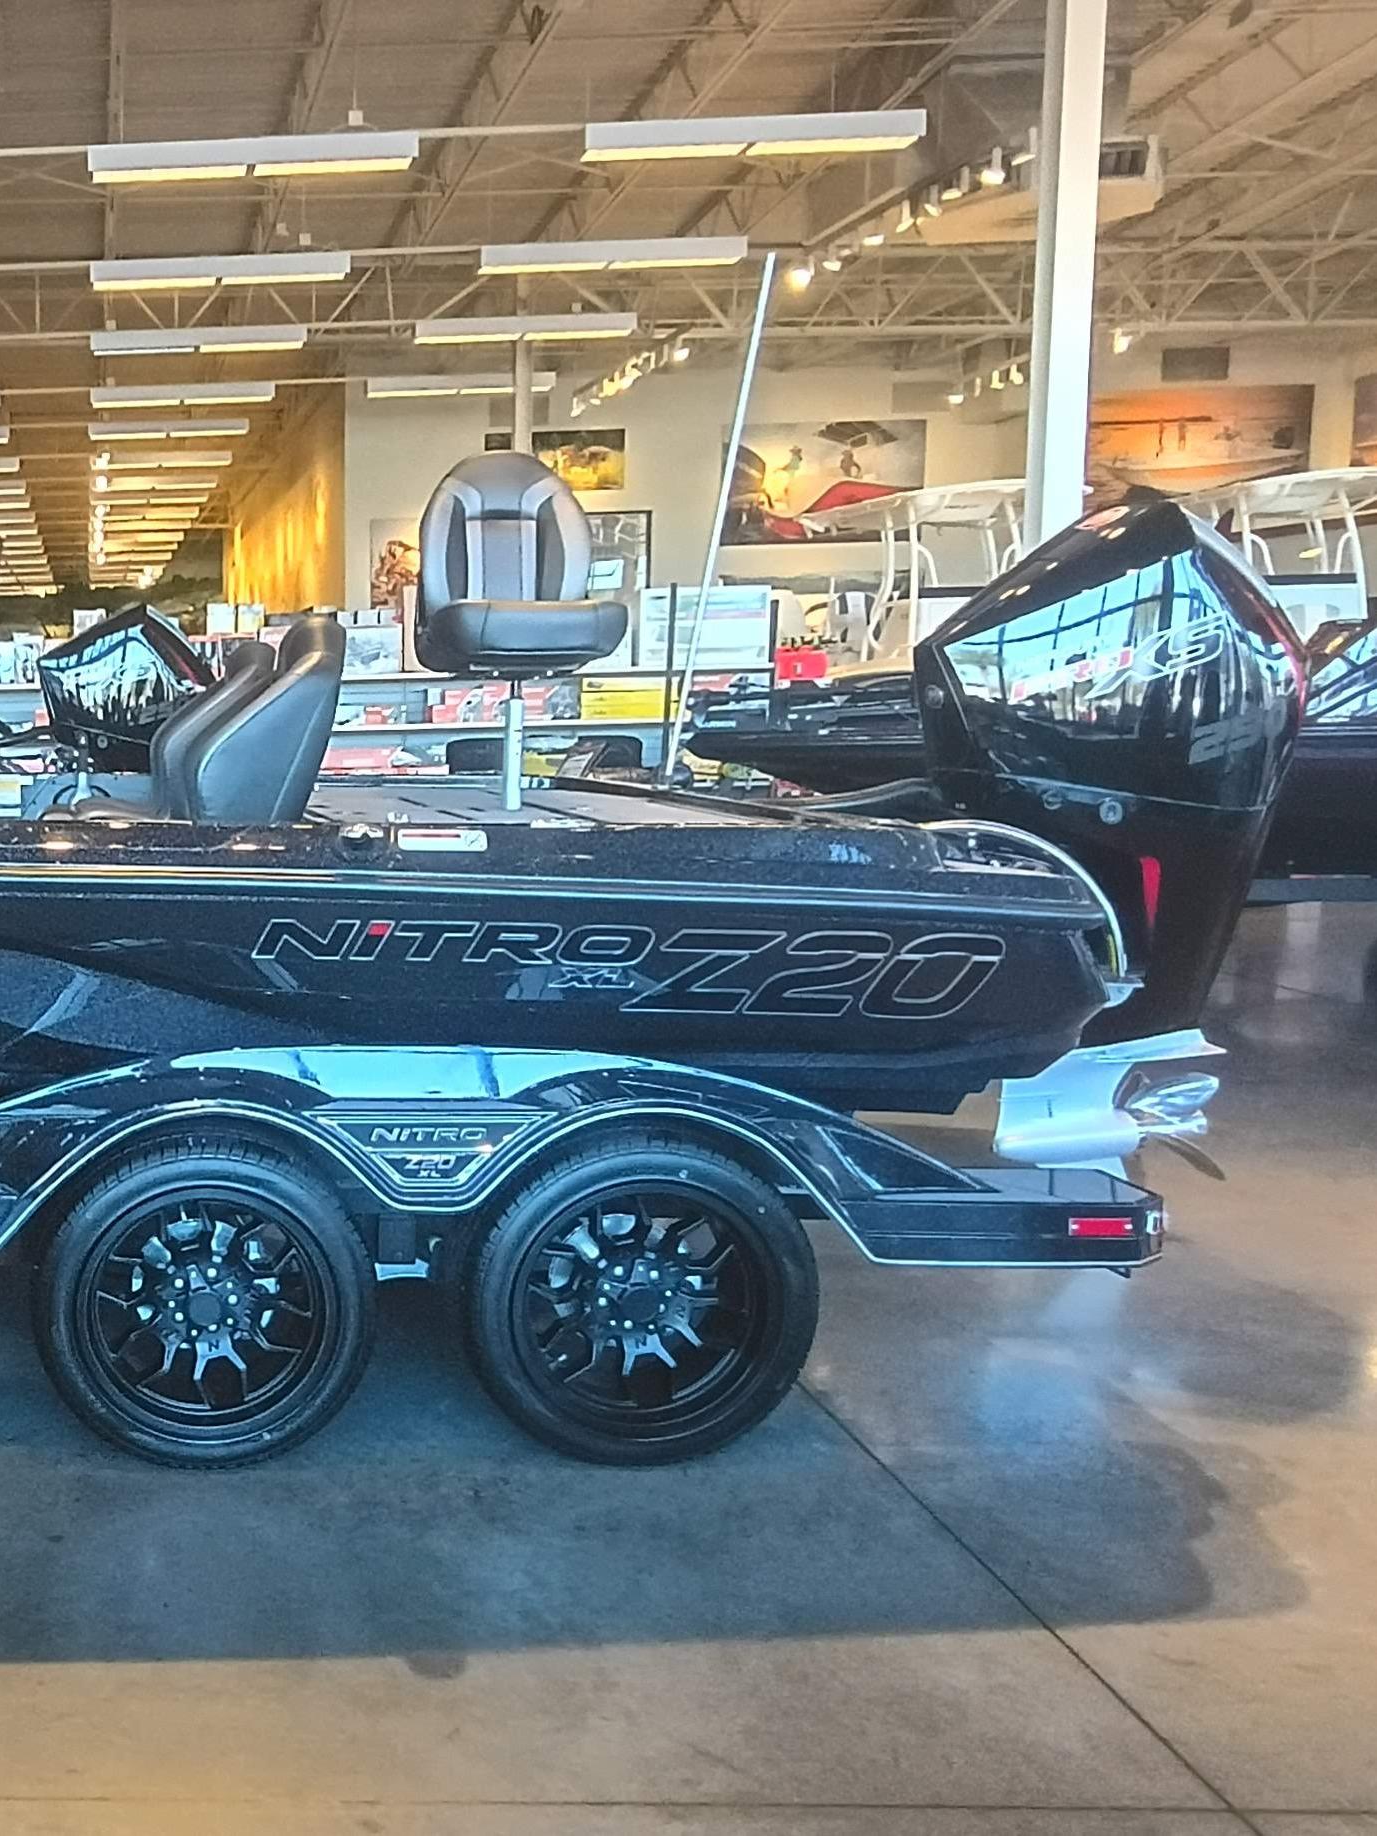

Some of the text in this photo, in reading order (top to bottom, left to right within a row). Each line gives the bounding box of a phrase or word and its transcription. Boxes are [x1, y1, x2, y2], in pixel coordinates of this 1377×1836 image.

[549, 967, 635, 989] XL
[619, 928, 1006, 1019] Z20
[404, 1154, 457, 1170] Z20
[417, 1170, 441, 1178] XL
